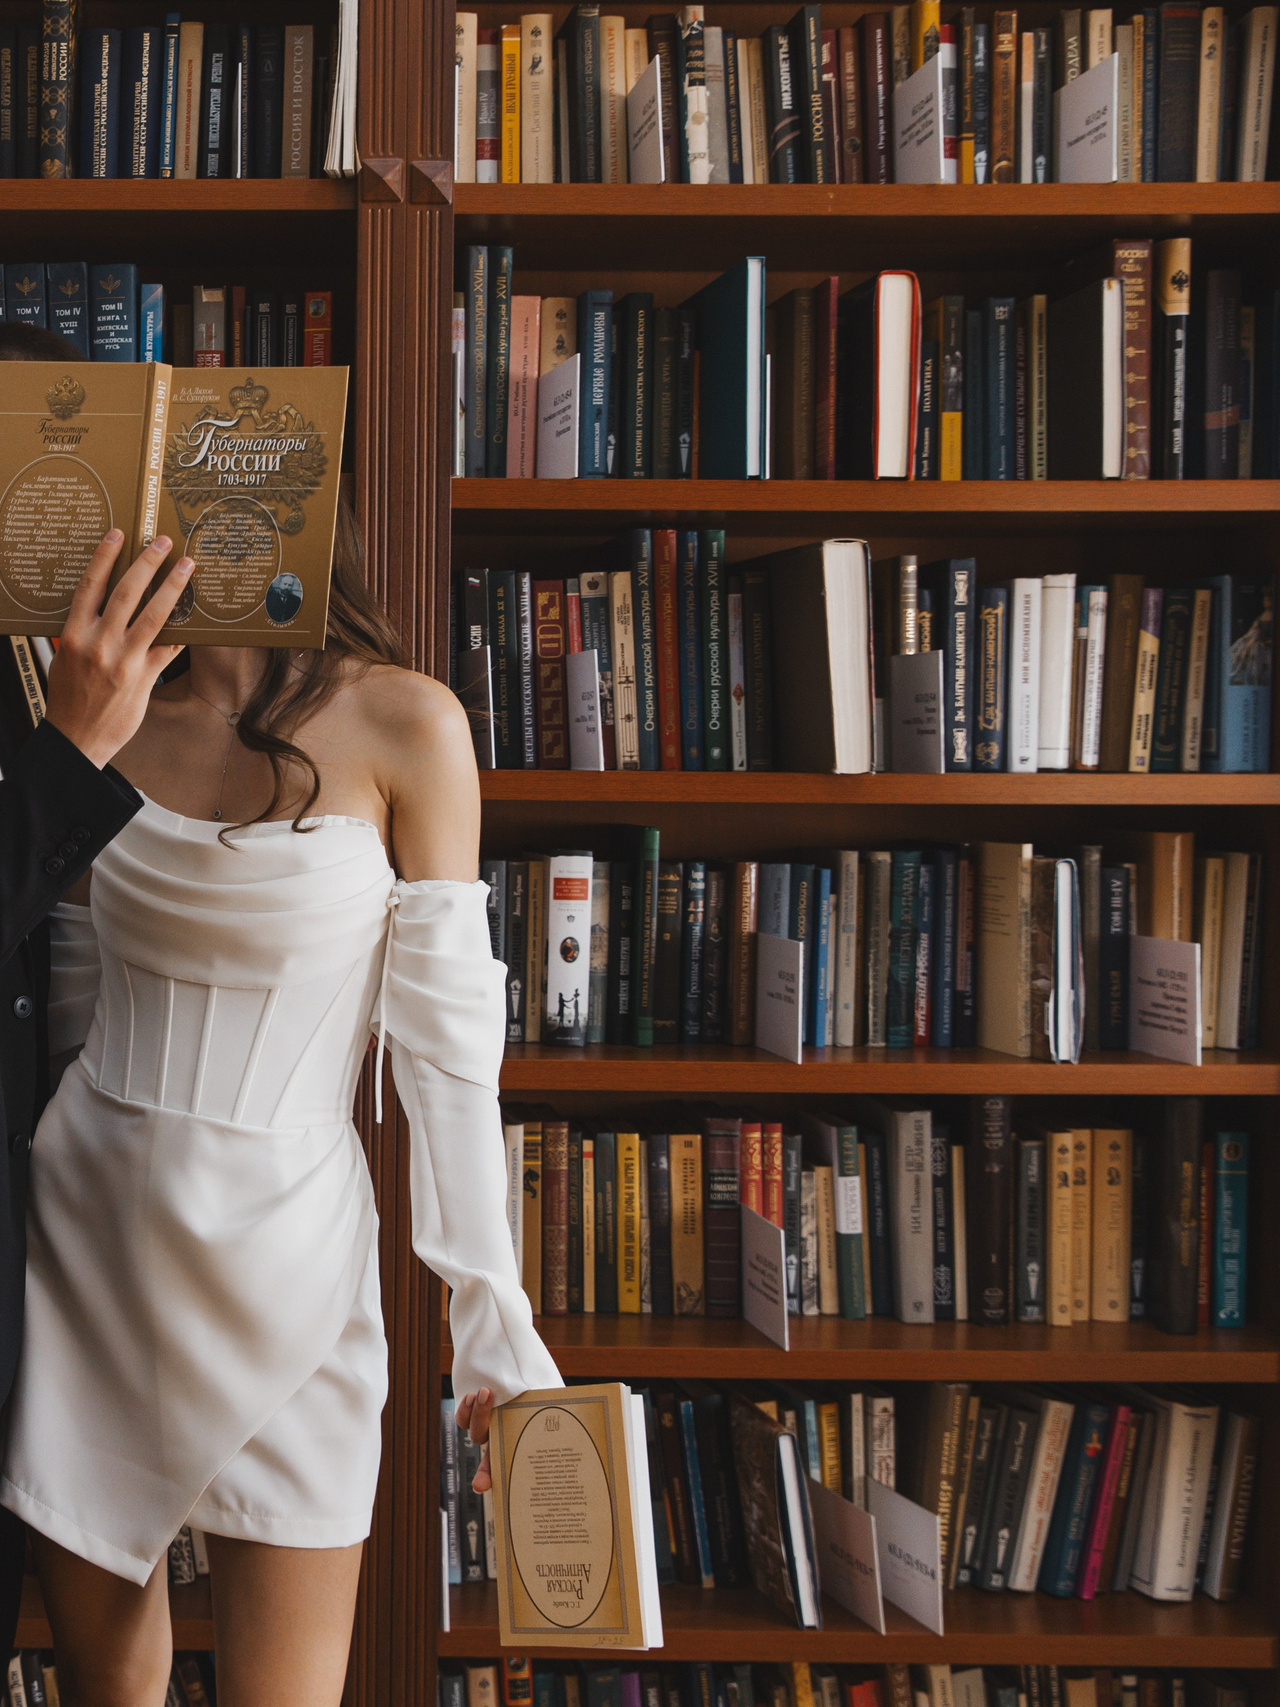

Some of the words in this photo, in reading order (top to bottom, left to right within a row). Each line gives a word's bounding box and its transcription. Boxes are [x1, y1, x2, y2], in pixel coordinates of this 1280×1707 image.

[1, 48, 10, 106] ОТЕЧЕСТВО
[59, 42, 67, 80] РОССИИ
[293, 36, 304, 93] ВОСТОК
[1, 109, 10, 140] НАШЕ
[811, 93, 823, 142] РОССИЯ
[291, 113, 302, 169] РОССИЯ
[73, 308, 81, 316] IV
[146, 311, 154, 350] КУЛЬТУРЫ
[594, 312, 605, 363] РОМАНОВЫ
[636, 310, 645, 369] РОССИЙСКОГО
[156, 380, 166, 422] 1703-1917
[592, 368, 604, 405] ПЕРВЫЕ
[635, 372, 644, 427] ГОСУДАРСТВА
[923, 359, 932, 412] ПОЛИТИКА
[35, 418, 89, 435] Губернаторы
[42, 433, 81, 444] РОССИИ
[178, 419, 307, 468] Губернаторы
[151, 428, 162, 468] РОССИИ
[206, 454, 280, 472] РОССИИ
[217, 474, 267, 486] 1703-1917
[143, 476, 158, 548] ГУБЕРНАТОРЫ
[638, 562, 648, 586] XVIII
[707, 561, 718, 586] XVIII
[497, 615, 505, 645] НАЧАЛА
[641, 590, 651, 639] культуры
[710, 590, 720, 639] культуры
[522, 623, 531, 672] ИСКУССТВЕ
[642, 643, 653, 686] русской
[709, 642, 721, 686] русской
[954, 612, 966, 707] БАНТЫШ-КАМЕНСКИЙ
[524, 675, 532, 715] РУССКОМ
[644, 690, 655, 731] Очерки
[709, 690, 720, 730] Очерки
[525, 727, 534, 762] БЕСЕДЫ
[1110, 912, 1122, 934] ТОМ
